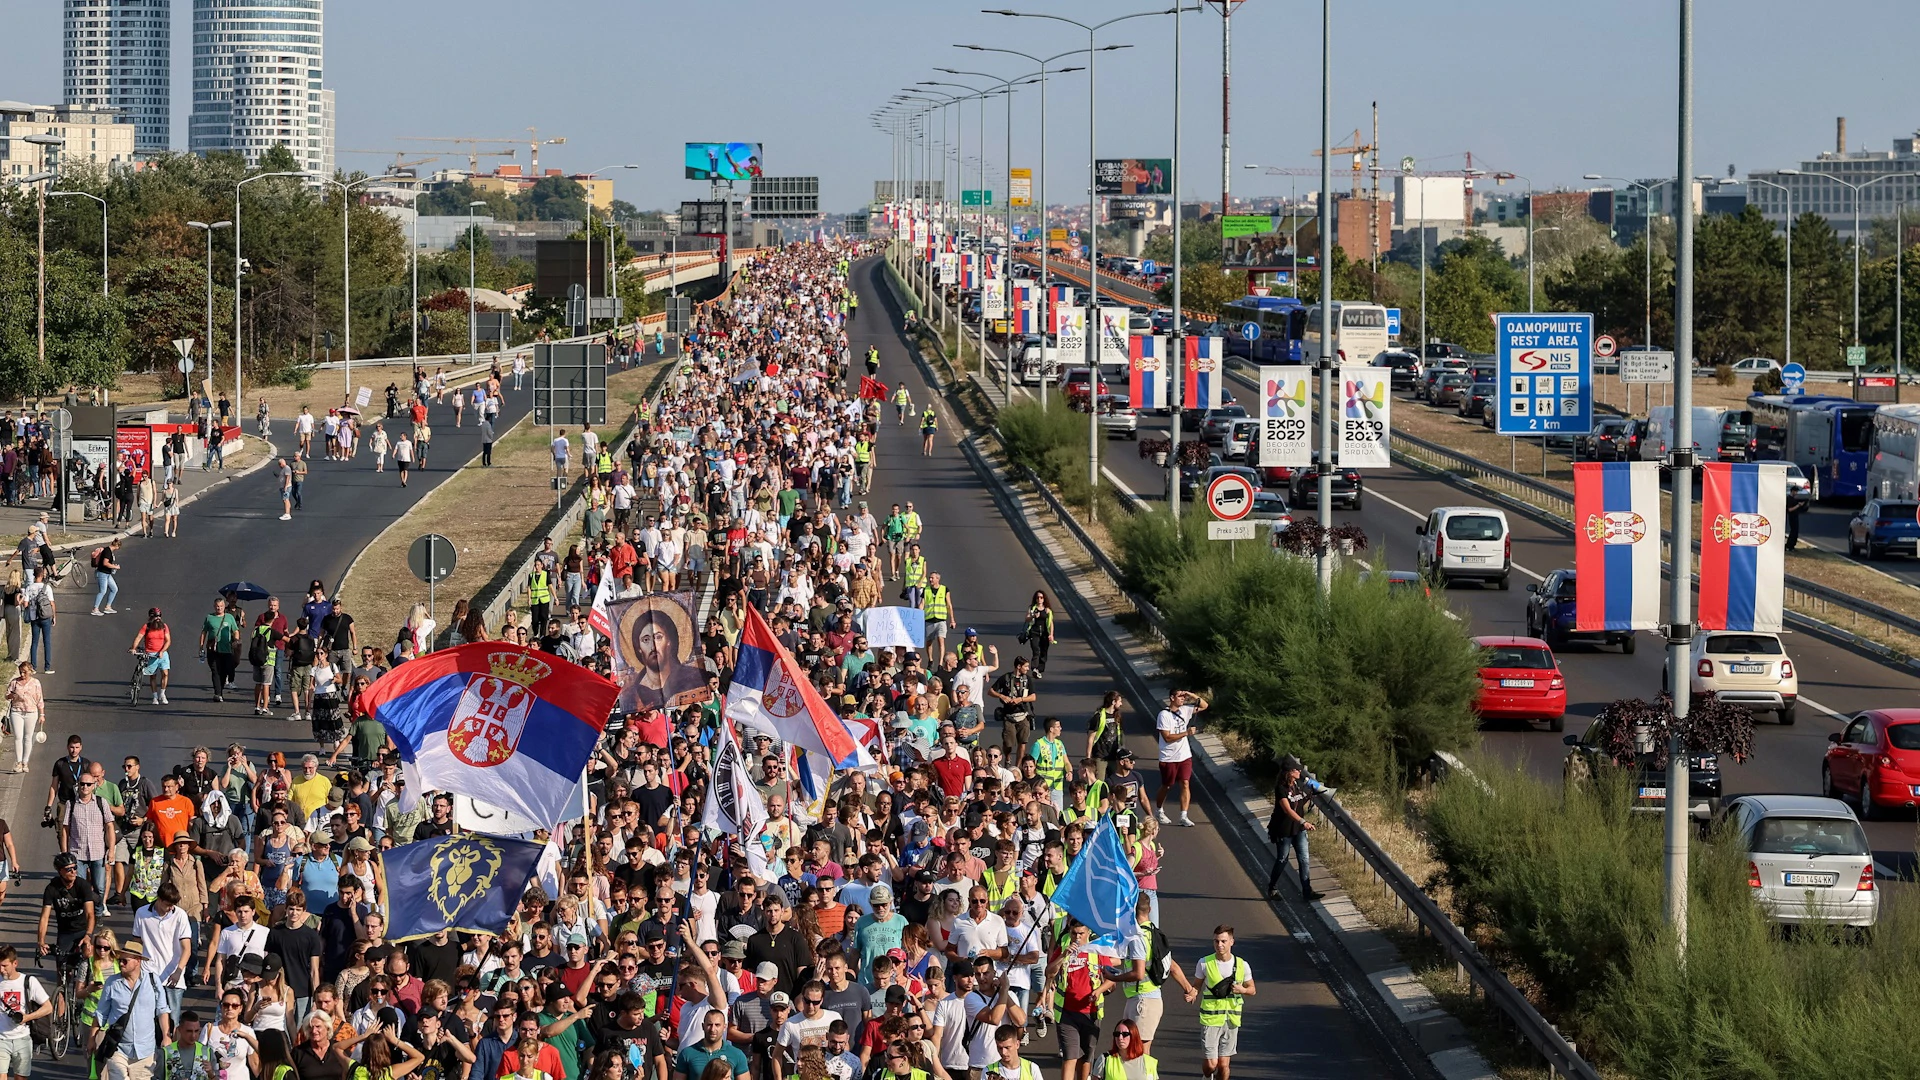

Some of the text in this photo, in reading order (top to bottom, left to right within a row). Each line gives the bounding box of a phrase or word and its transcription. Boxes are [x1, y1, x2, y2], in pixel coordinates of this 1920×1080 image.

[1346, 310, 1381, 325] wint
[1507, 322, 1582, 333] ОДМОРИШТЕ
[1511, 336, 1578, 346] REST AREA
[1550, 353, 1571, 362] NIS
[1267, 420, 1305, 429] EXPO
[1346, 421, 1383, 430] EXPO
[1530, 419, 1560, 429] 2 km
[1267, 431, 1305, 440] 2027
[1346, 432, 1383, 441] 2027
